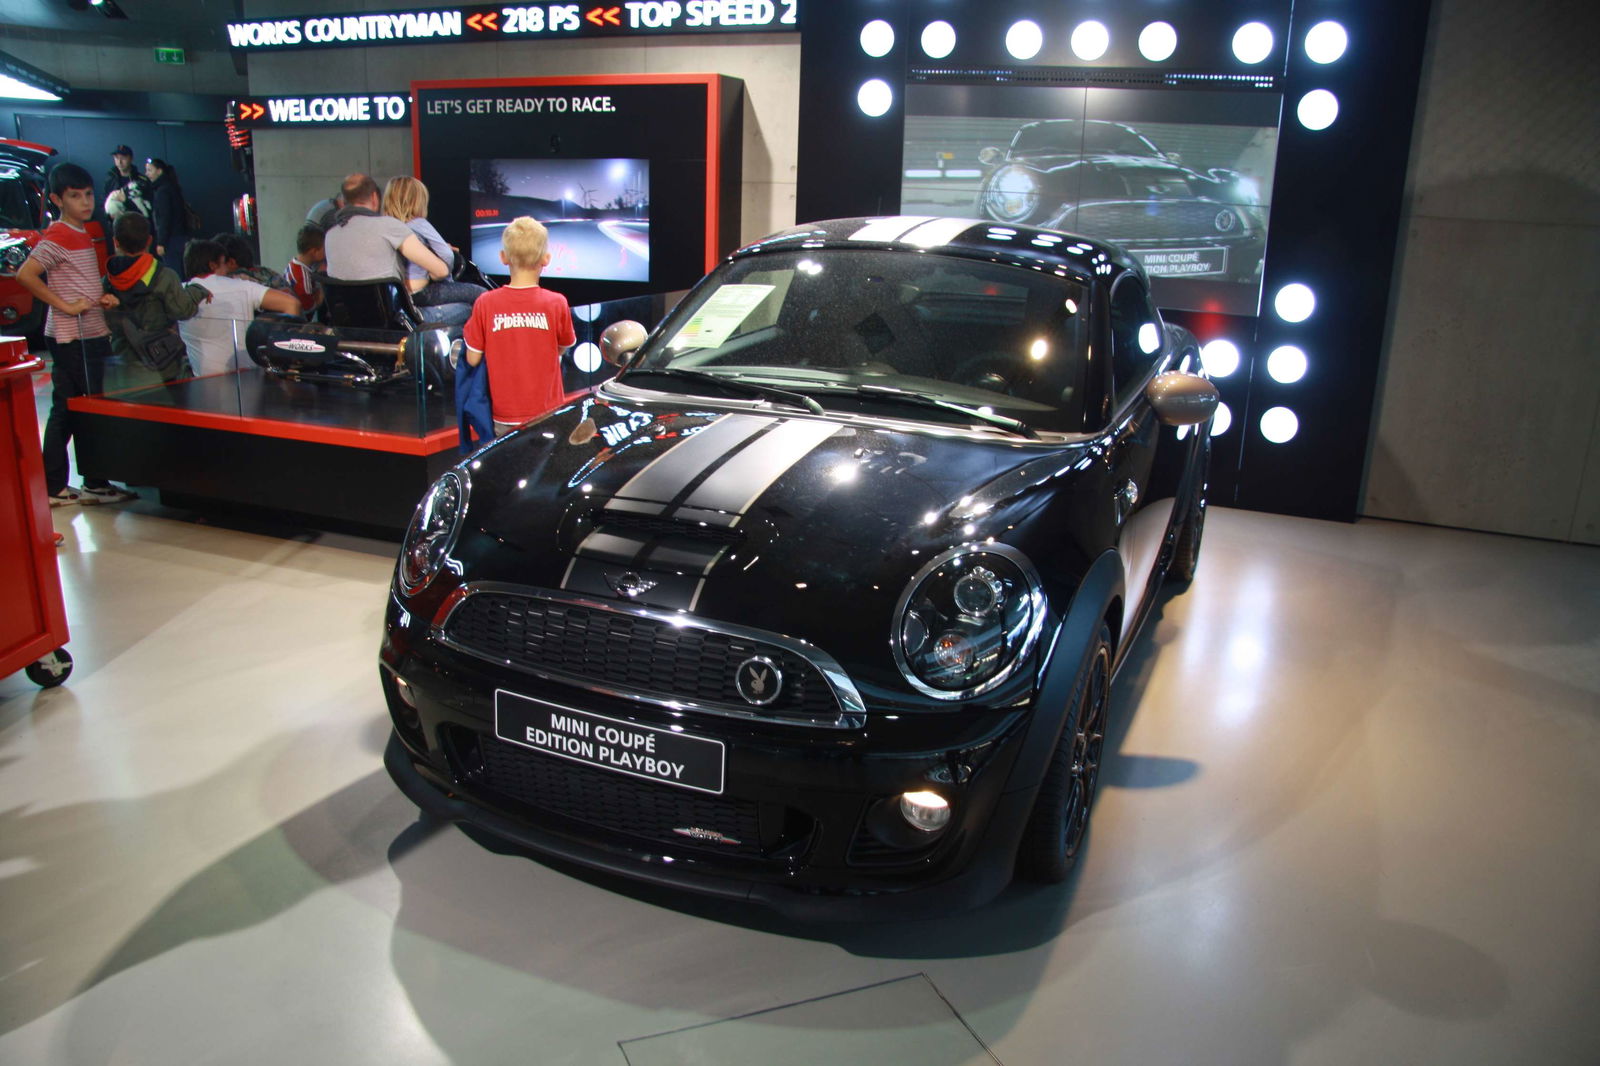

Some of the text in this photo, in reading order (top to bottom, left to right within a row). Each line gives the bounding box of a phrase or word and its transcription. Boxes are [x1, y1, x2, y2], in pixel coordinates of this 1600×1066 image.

[227, 21, 302, 47] WORKS
[304, 11, 462, 43] COUNTRYMAN
[502, 7, 544, 33] 218
[549, 5, 580, 31] PS
[625, 1, 681, 28] TOP
[685, 0, 775, 27] SPEED
[268, 96, 405, 122] WELCOME TO
[426, 96, 616, 114] LET'S GET READY TO RACE.
[1144, 254, 1166, 264] MINI
[1169, 263, 1210, 273] PLAYBOY
[492, 313, 549, 332] SPIDER-MAN
[551, 713, 656, 753] MINI COUPÉ
[526, 726, 684, 779] EDITION PLAYBOY
